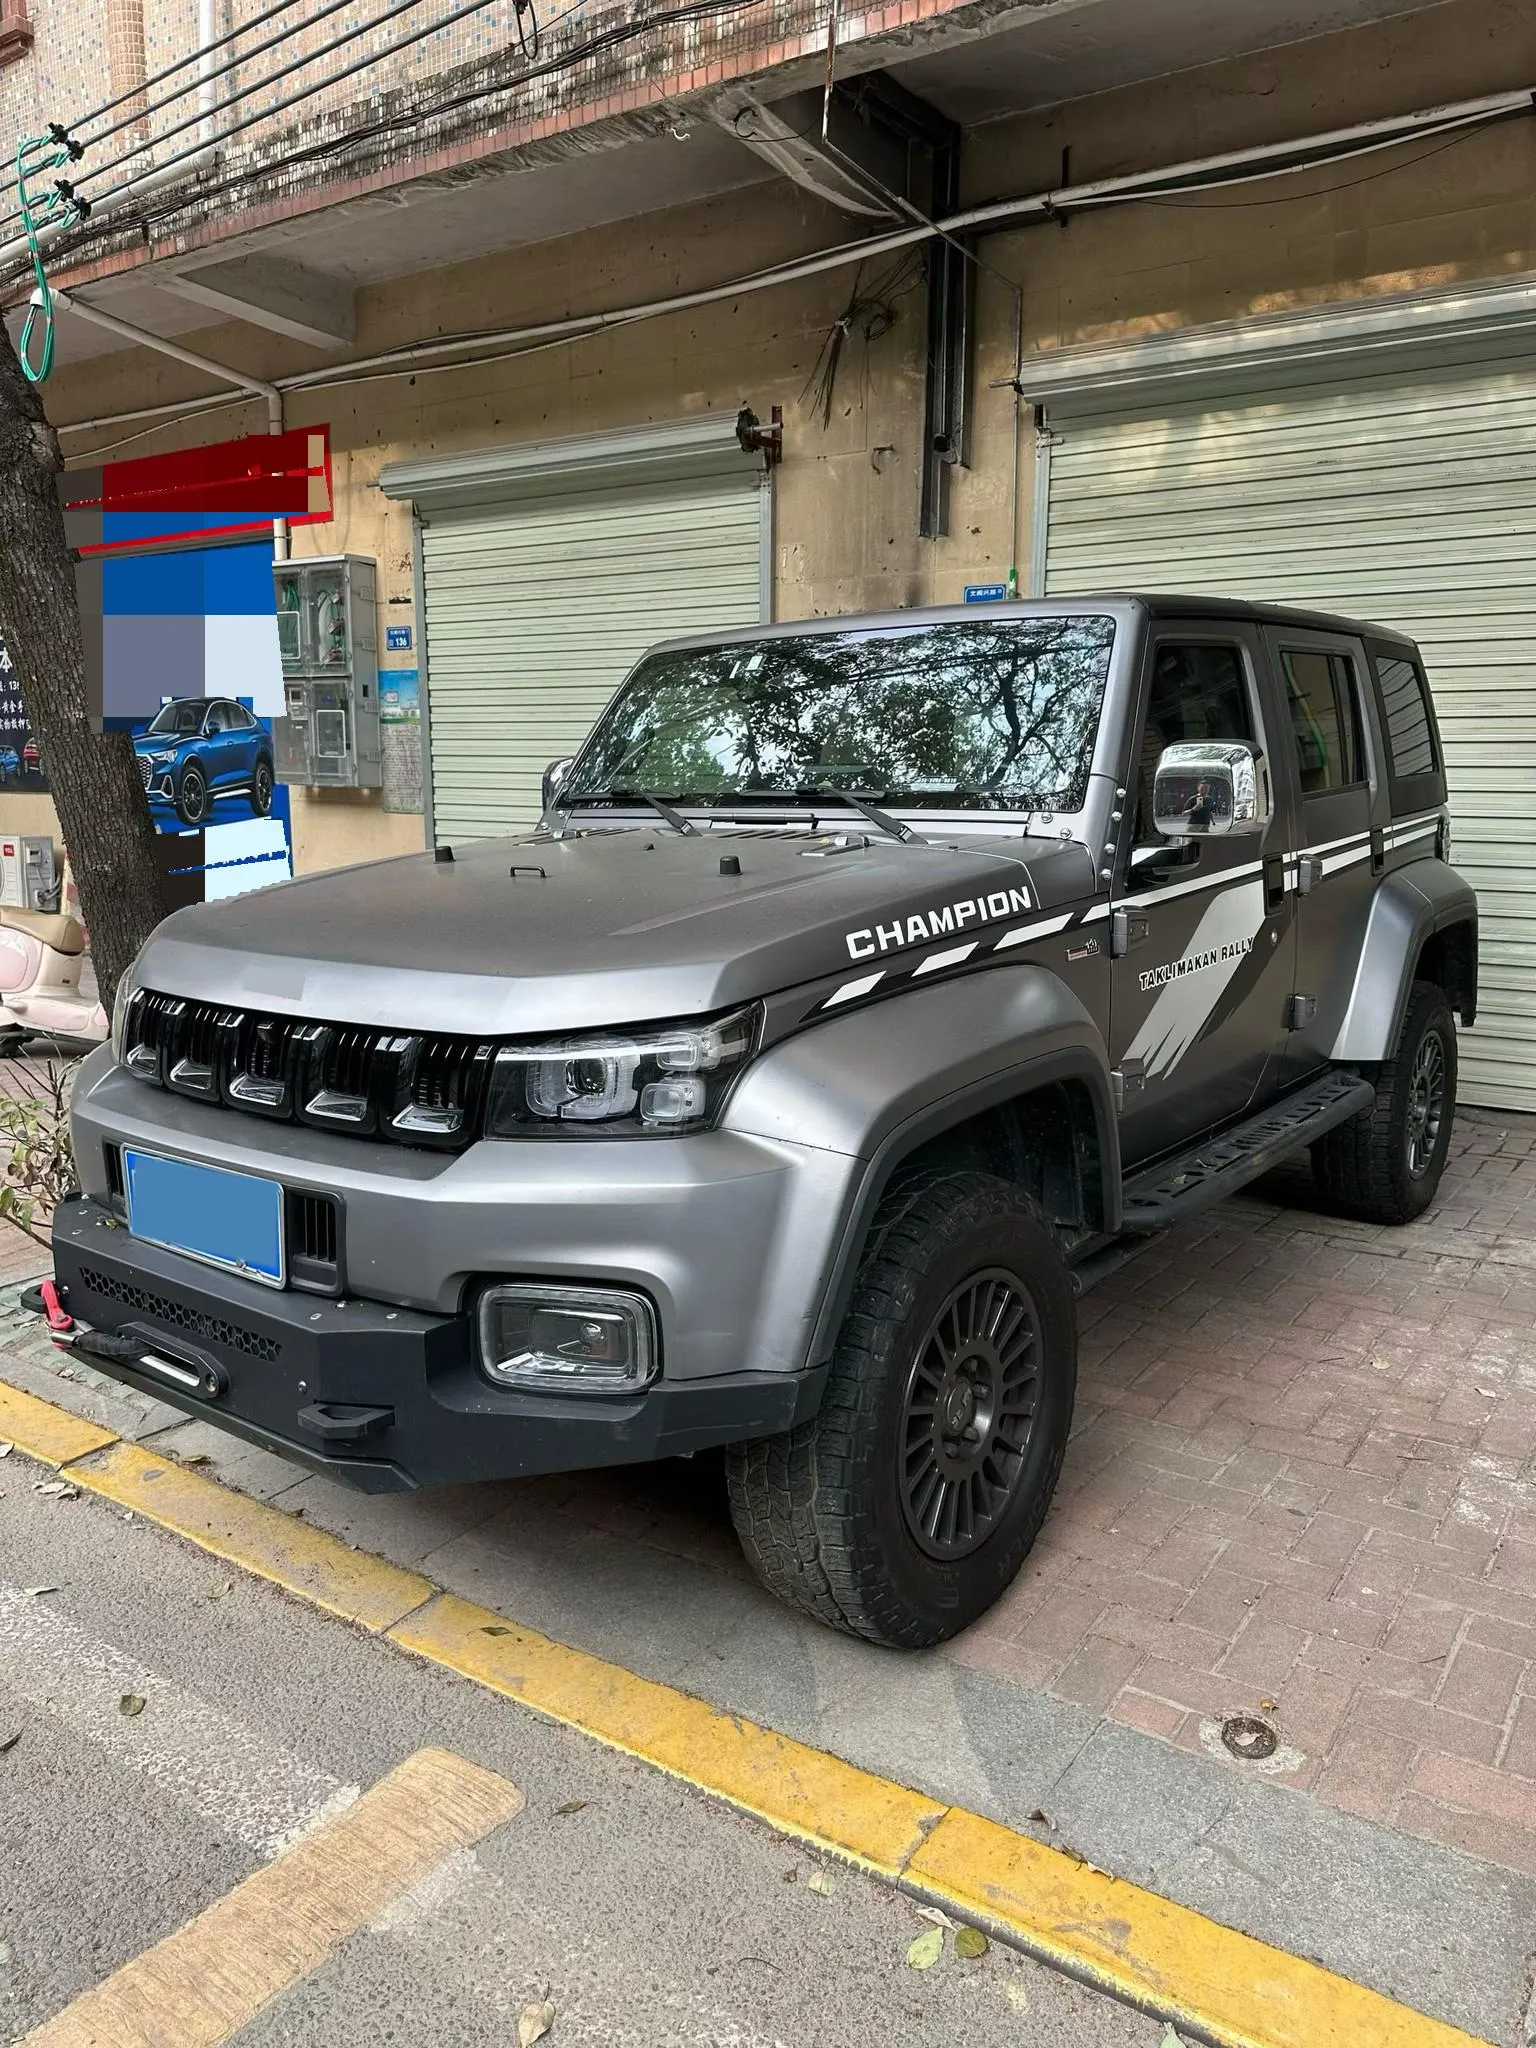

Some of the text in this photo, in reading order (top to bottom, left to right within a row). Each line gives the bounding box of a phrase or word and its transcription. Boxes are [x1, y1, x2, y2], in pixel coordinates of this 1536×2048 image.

[396, 637, 407, 646] 136
[846, 886, 1031, 960] CHAMPION
[1139, 948, 1218, 991] TAKLIMAKAN
[1220, 936, 1254, 962] RALLY
